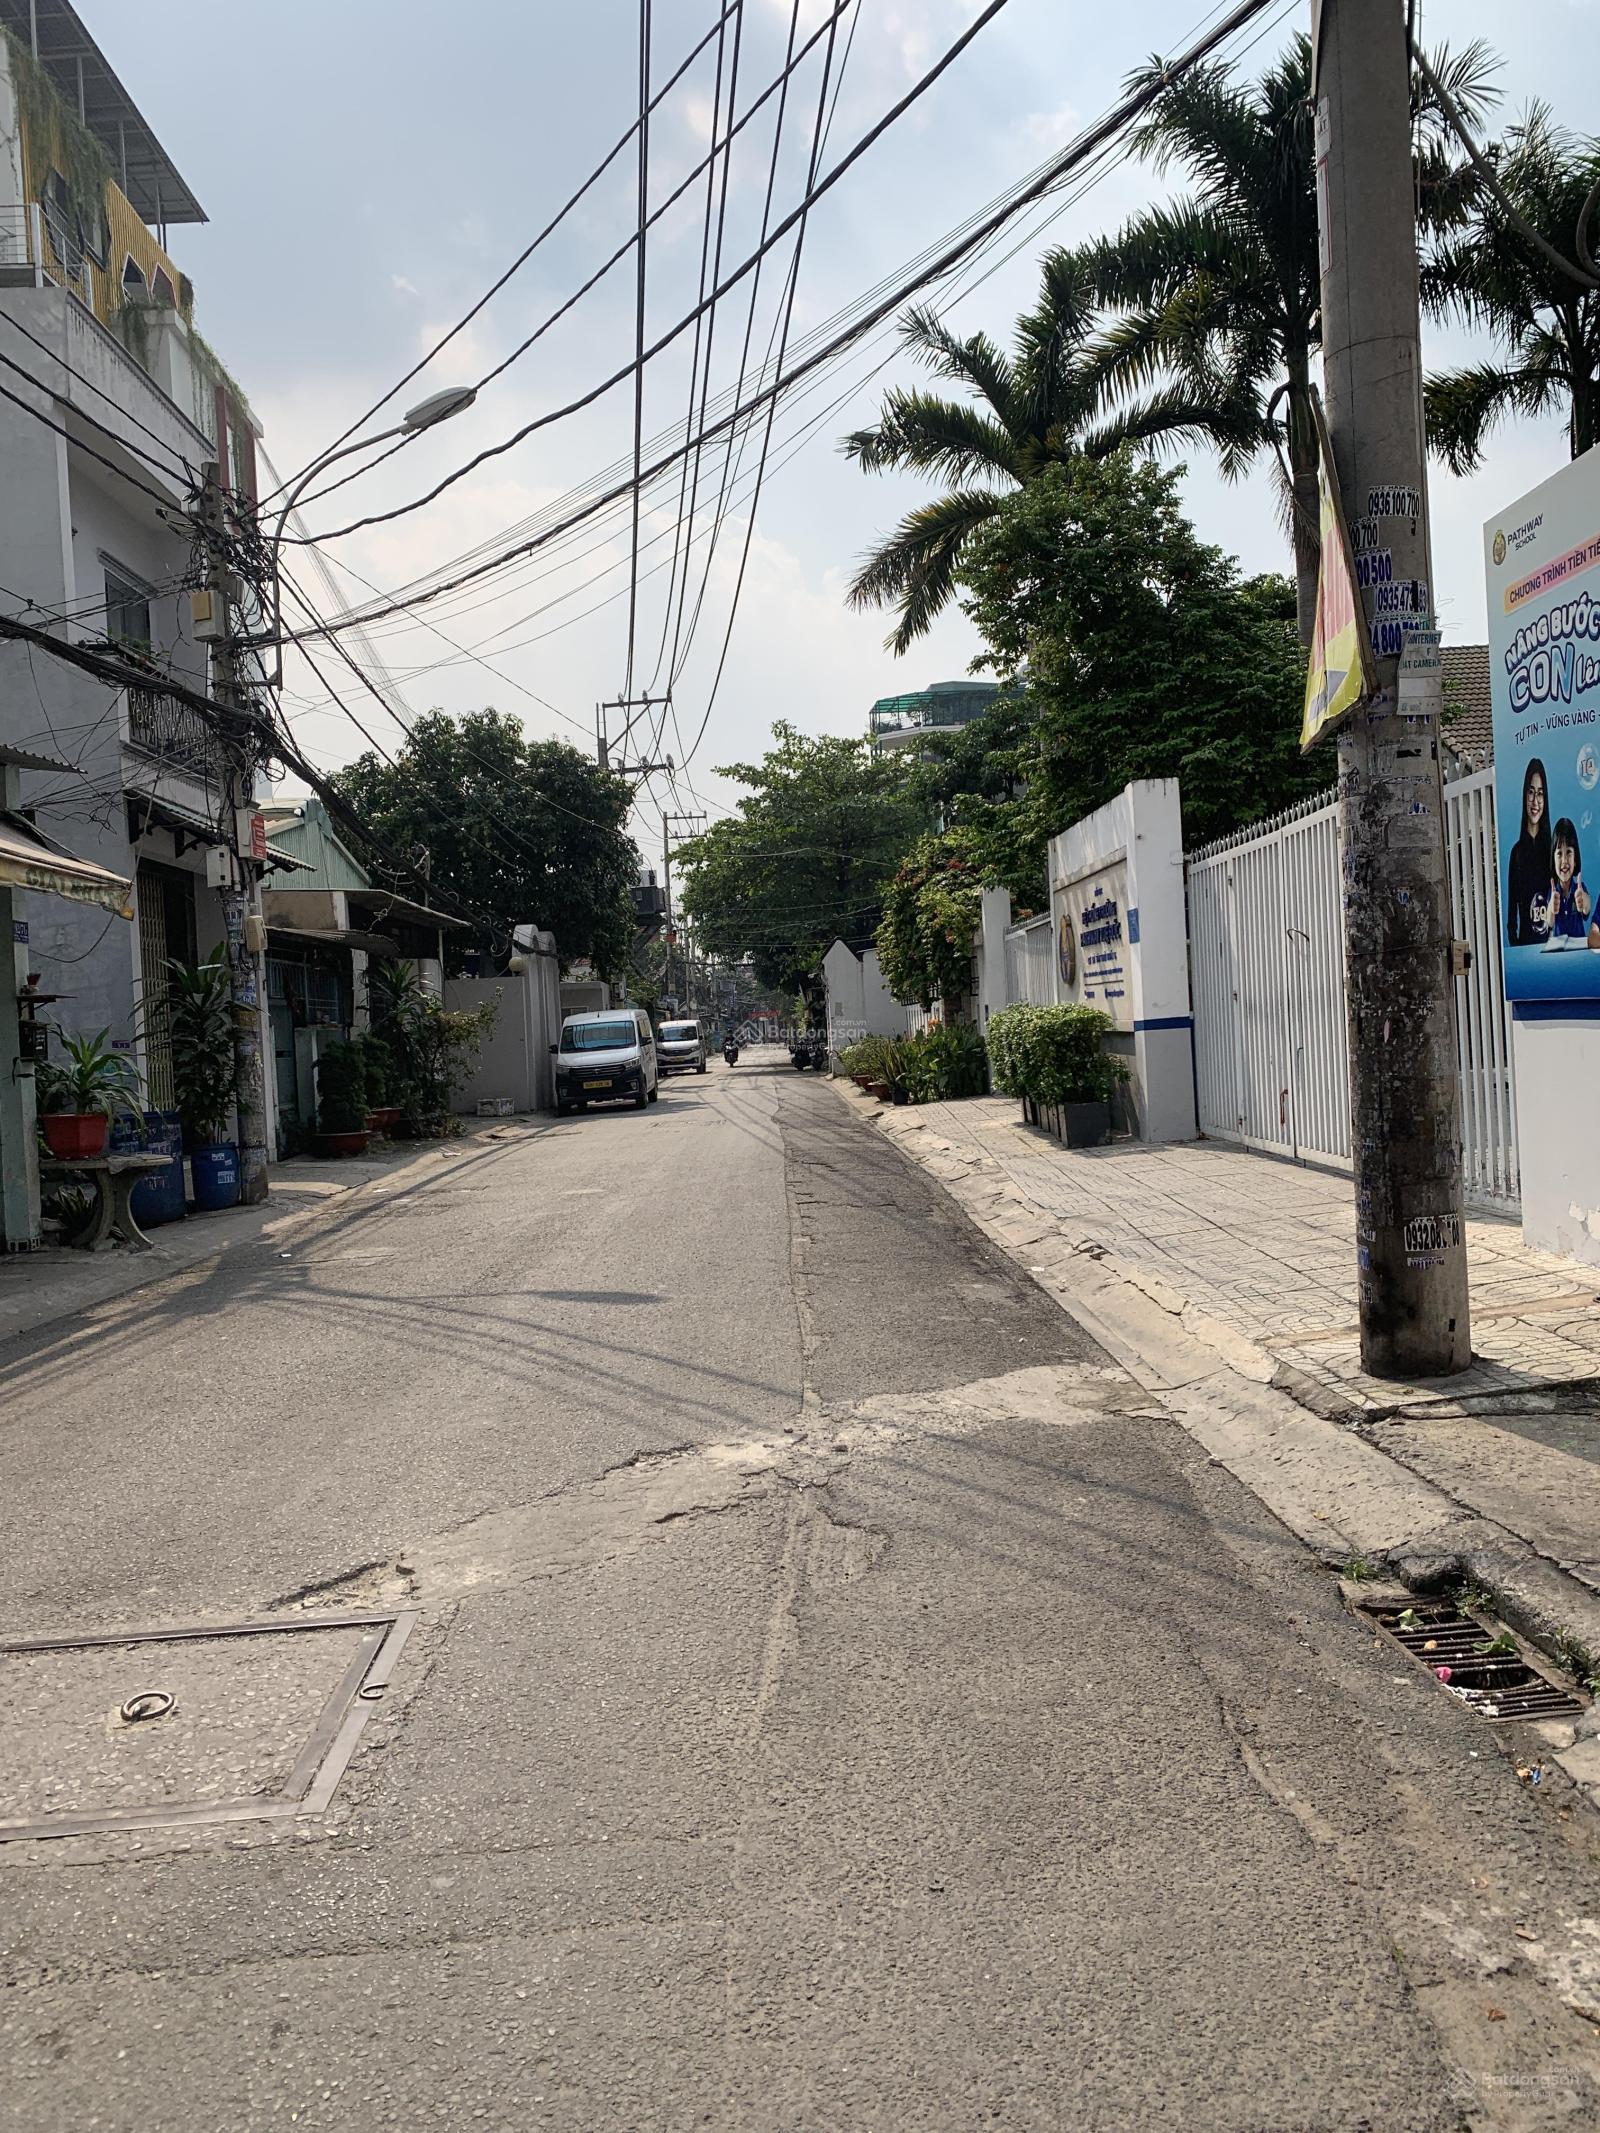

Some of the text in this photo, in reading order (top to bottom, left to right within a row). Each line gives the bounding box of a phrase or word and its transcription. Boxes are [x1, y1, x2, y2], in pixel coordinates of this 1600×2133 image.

[1368, 491, 1420, 517] 0936.100.700
[1507, 513, 1543, 545] PATHWAY
[1515, 532, 1536, 551] SCHOOL
[1509, 575, 1541, 603] CHƯƠNG
[1542, 560, 1566, 585] TRÌNH
[1567, 549, 1587, 571] TIỀN
[1505, 591, 1600, 675] NÂNG BƯỚC
[1509, 642, 1575, 713] CON
[1515, 727, 1526, 745] TỰ
[1526, 720, 1539, 738] TIN
[1545, 712, 1570, 730] VỮNG
[1571, 708, 1596, 726] VÀNG
